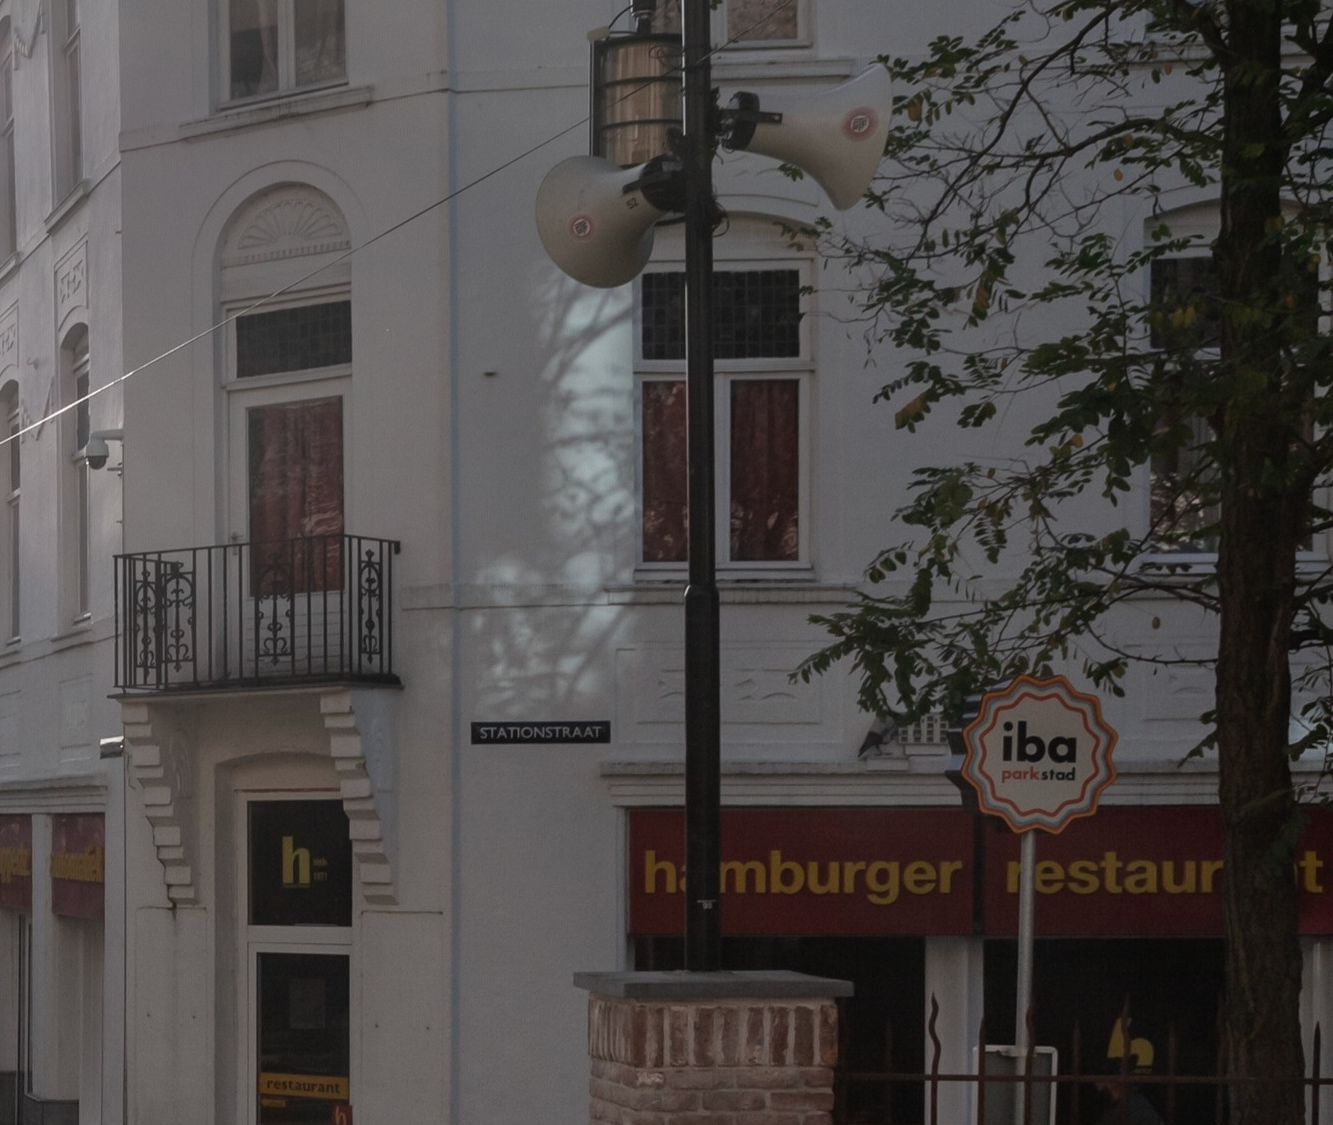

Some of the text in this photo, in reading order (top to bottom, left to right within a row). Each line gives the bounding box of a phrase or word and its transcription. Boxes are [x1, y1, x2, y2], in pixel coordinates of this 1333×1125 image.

[479, 726, 602, 739] STATIONSTRAAT
[1002, 720, 1077, 763] iba
[1002, 766, 1076, 783] parkstad
[282, 836, 310, 885] h
[645, 850, 963, 905] hmburger
[1006, 850, 1324, 895] restaurt
[266, 1079, 341, 1094] restaurant
